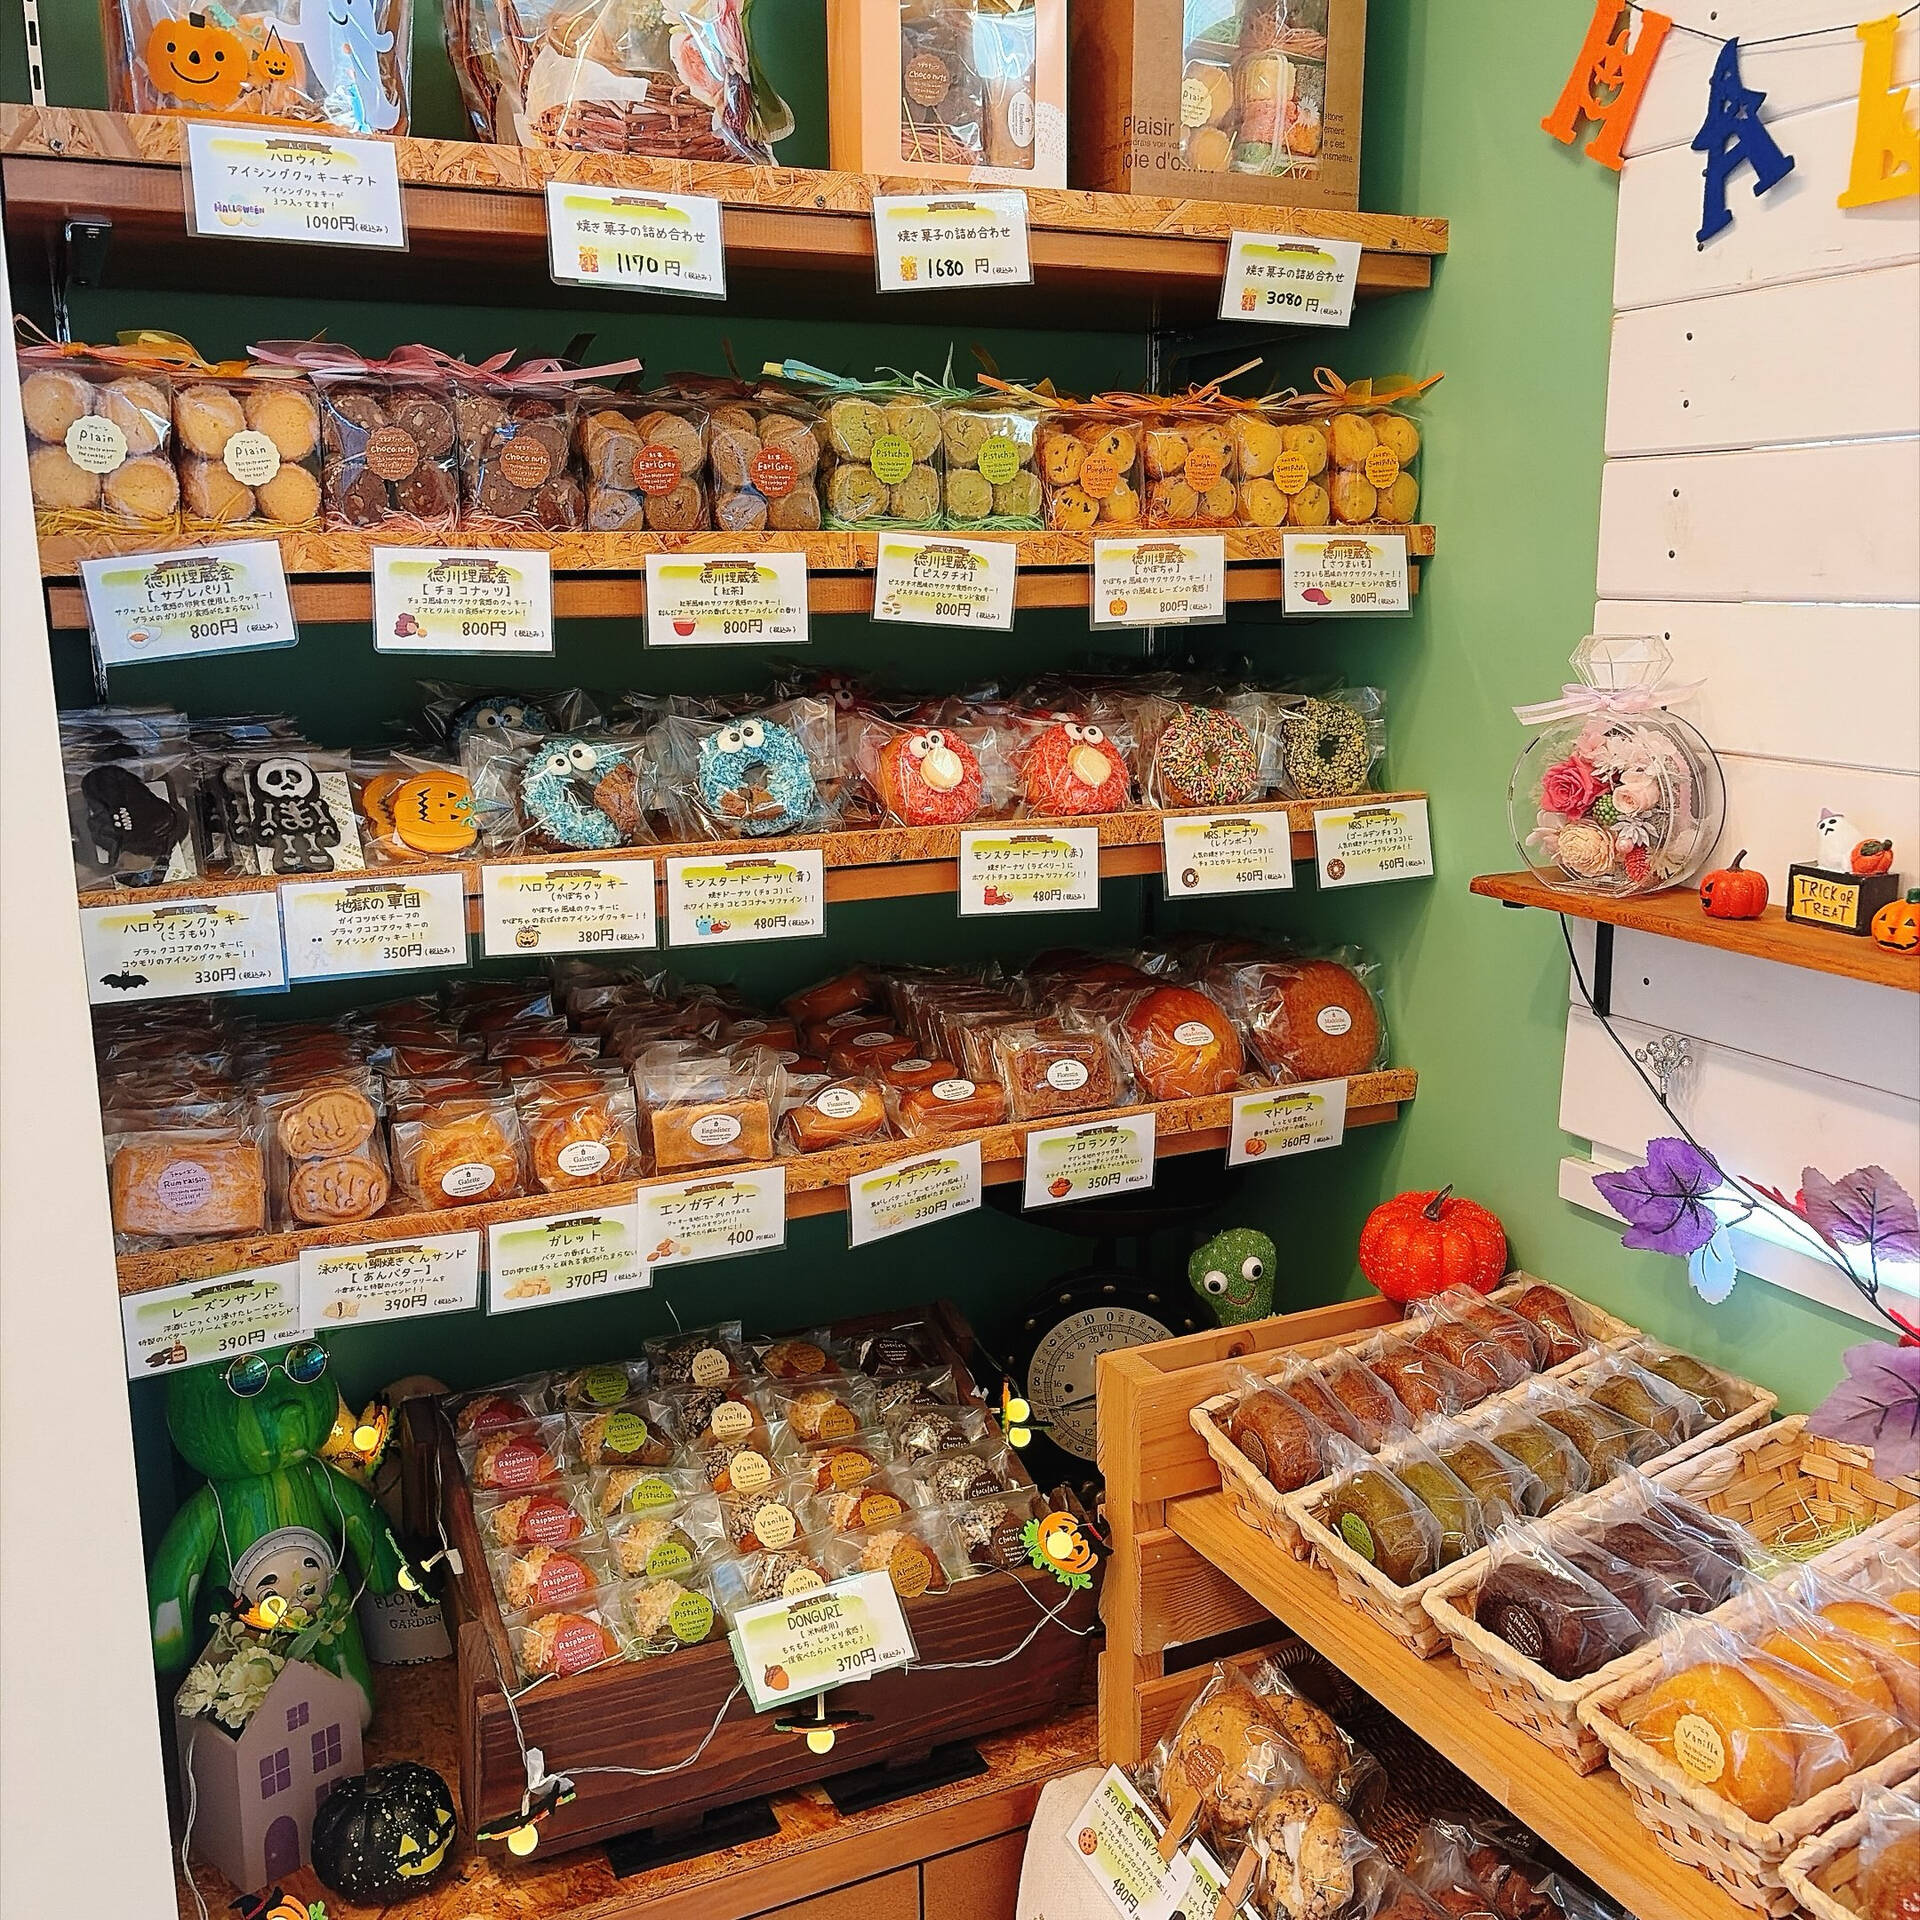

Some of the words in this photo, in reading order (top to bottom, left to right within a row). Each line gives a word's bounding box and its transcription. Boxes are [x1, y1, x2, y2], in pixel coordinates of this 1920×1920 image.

[1123, 115, 1174, 136] Plaisir
[270, 153, 331, 165] ハロウィン
[1122, 149, 1149, 174] joie
[227, 165, 376, 186] アイシングクッキーギフト
[576, 219, 706, 243] 焼き菓子の詰め合わせ
[897, 226, 1011, 242] 焼き菓子の詰め合わせ
[929, 258, 963, 279] 1680
[1245, 265, 1344, 283] 焼き菓子の詰め合わせ
[1267, 291, 1302, 307] 3080
[79, 430, 114, 443] Plain
[235, 445, 266, 457] Plain
[913, 553, 980, 571] 徳川埋蔵金
[1132, 552, 1187, 565] 徳川埋蔵金
[1323, 549, 1373, 560] 徳川埋蔵金
[143, 565, 235, 589] 徳川埋蔵金
[427, 568, 511, 585] 徳川埋蔵金
[700, 571, 762, 584] 徳川埋蔵金
[519, 879, 629, 893] ハロウィンクッキー
[1799, 878, 1838, 901] TRICK
[1840, 890, 1854, 904] OR
[335, 892, 421, 914] 地獄の軍団
[1800, 898, 1850, 922] TREAT
[123, 914, 250, 934] ハロウィンクッキー
[338, 912, 420, 924] ガイコツがモチーフの
[330, 922, 429, 936] ブラックココアクッキーの
[133, 940, 244, 957] ブラックココアのクッキーに
[1264, 1102, 1314, 1118] マドレーヌ
[1067, 1136, 1128, 1152] フロランタン
[164, 1180, 182, 1189] Rum
[883, 1166, 951, 1191] フィナンシェ
[660, 1193, 756, 1216] エンガディナー
[549, 1230, 601, 1247] ガレット
[727, 1229, 753, 1246] 400
[173, 1287, 278, 1318] レーズンサンド
[697, 1359, 723, 1371] Vanilla
[717, 1412, 747, 1422] Vanilla
[498, 1455, 534, 1468] Raspberry
[735, 1460, 765, 1473] Vanilla
[638, 1491, 672, 1500] Pistachio
[530, 1514, 566, 1526] Raspberry
[760, 1515, 789, 1528] Vanilla
[652, 1556, 688, 1569] Pistachio
[543, 1571, 579, 1588] Raspberry
[788, 1580, 818, 1595] Vanilla
[674, 1606, 709, 1619] Pistachio
[787, 1604, 844, 1630] DONGURI
[389, 1614, 442, 1629] GARDEN
[558, 1632, 596, 1651] Raspberry
[1683, 1727, 1719, 1756] Vanilla
